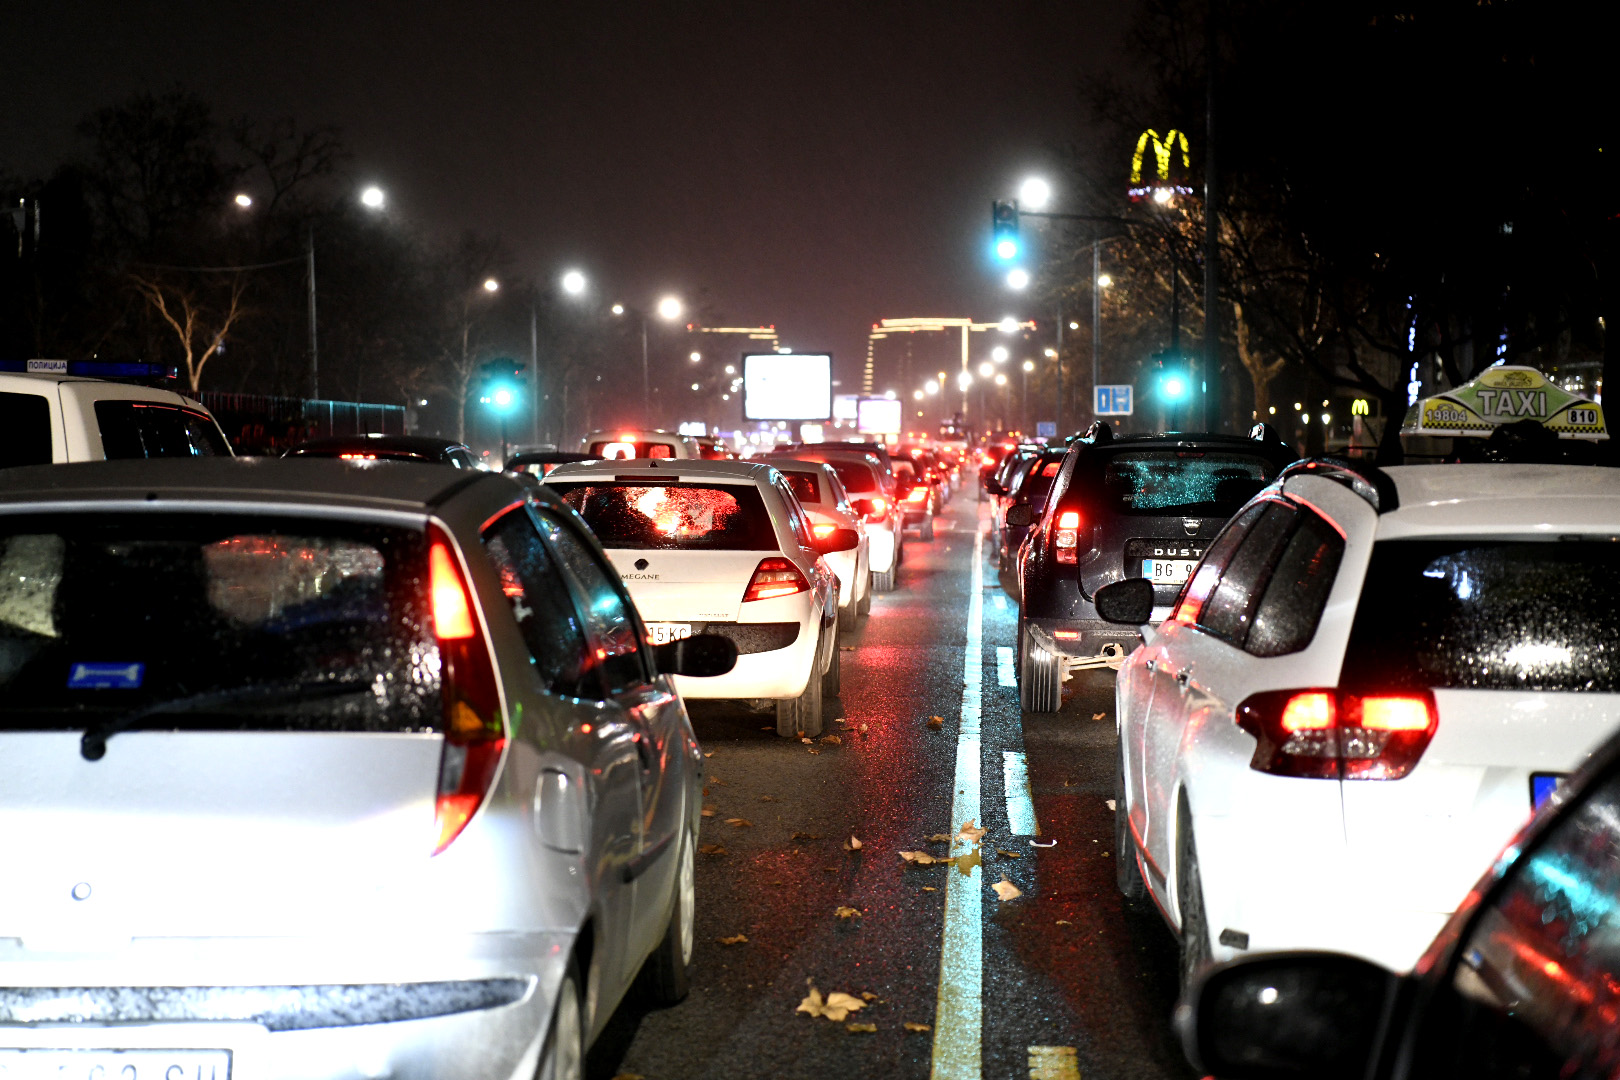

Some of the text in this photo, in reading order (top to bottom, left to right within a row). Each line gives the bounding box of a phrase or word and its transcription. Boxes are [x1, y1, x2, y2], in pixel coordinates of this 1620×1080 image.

[28, 361, 67, 370] ПОЛИЦИЈА
[1477, 389, 1547, 417] TAXI
[1425, 409, 1467, 422] 19804
[1570, 410, 1595, 422] 810
[1155, 563, 1173, 577] BG
[620, 573, 660, 581] MEGANE
